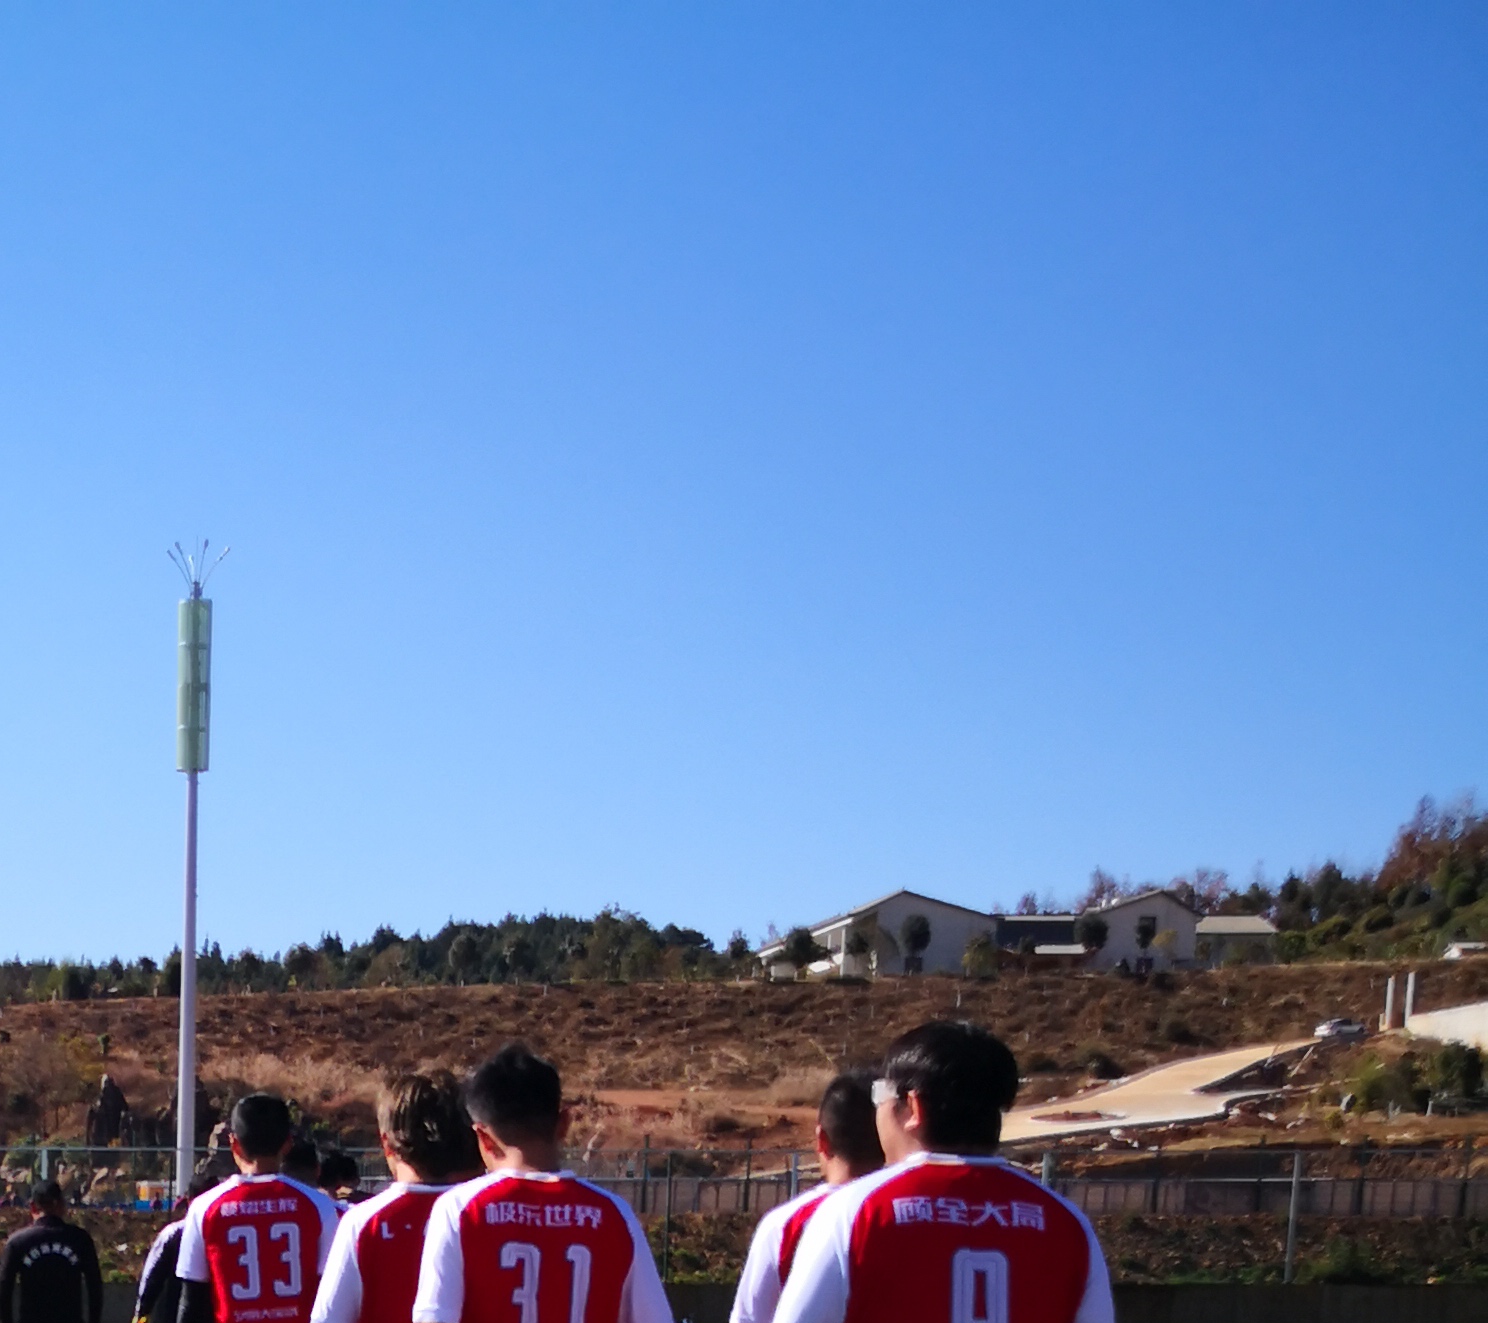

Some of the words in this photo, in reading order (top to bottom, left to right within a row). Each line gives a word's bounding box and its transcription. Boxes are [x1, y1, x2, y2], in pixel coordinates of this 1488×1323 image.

[891, 1195, 1046, 1232] 顾全大局
[227, 1221, 303, 1301] 33
